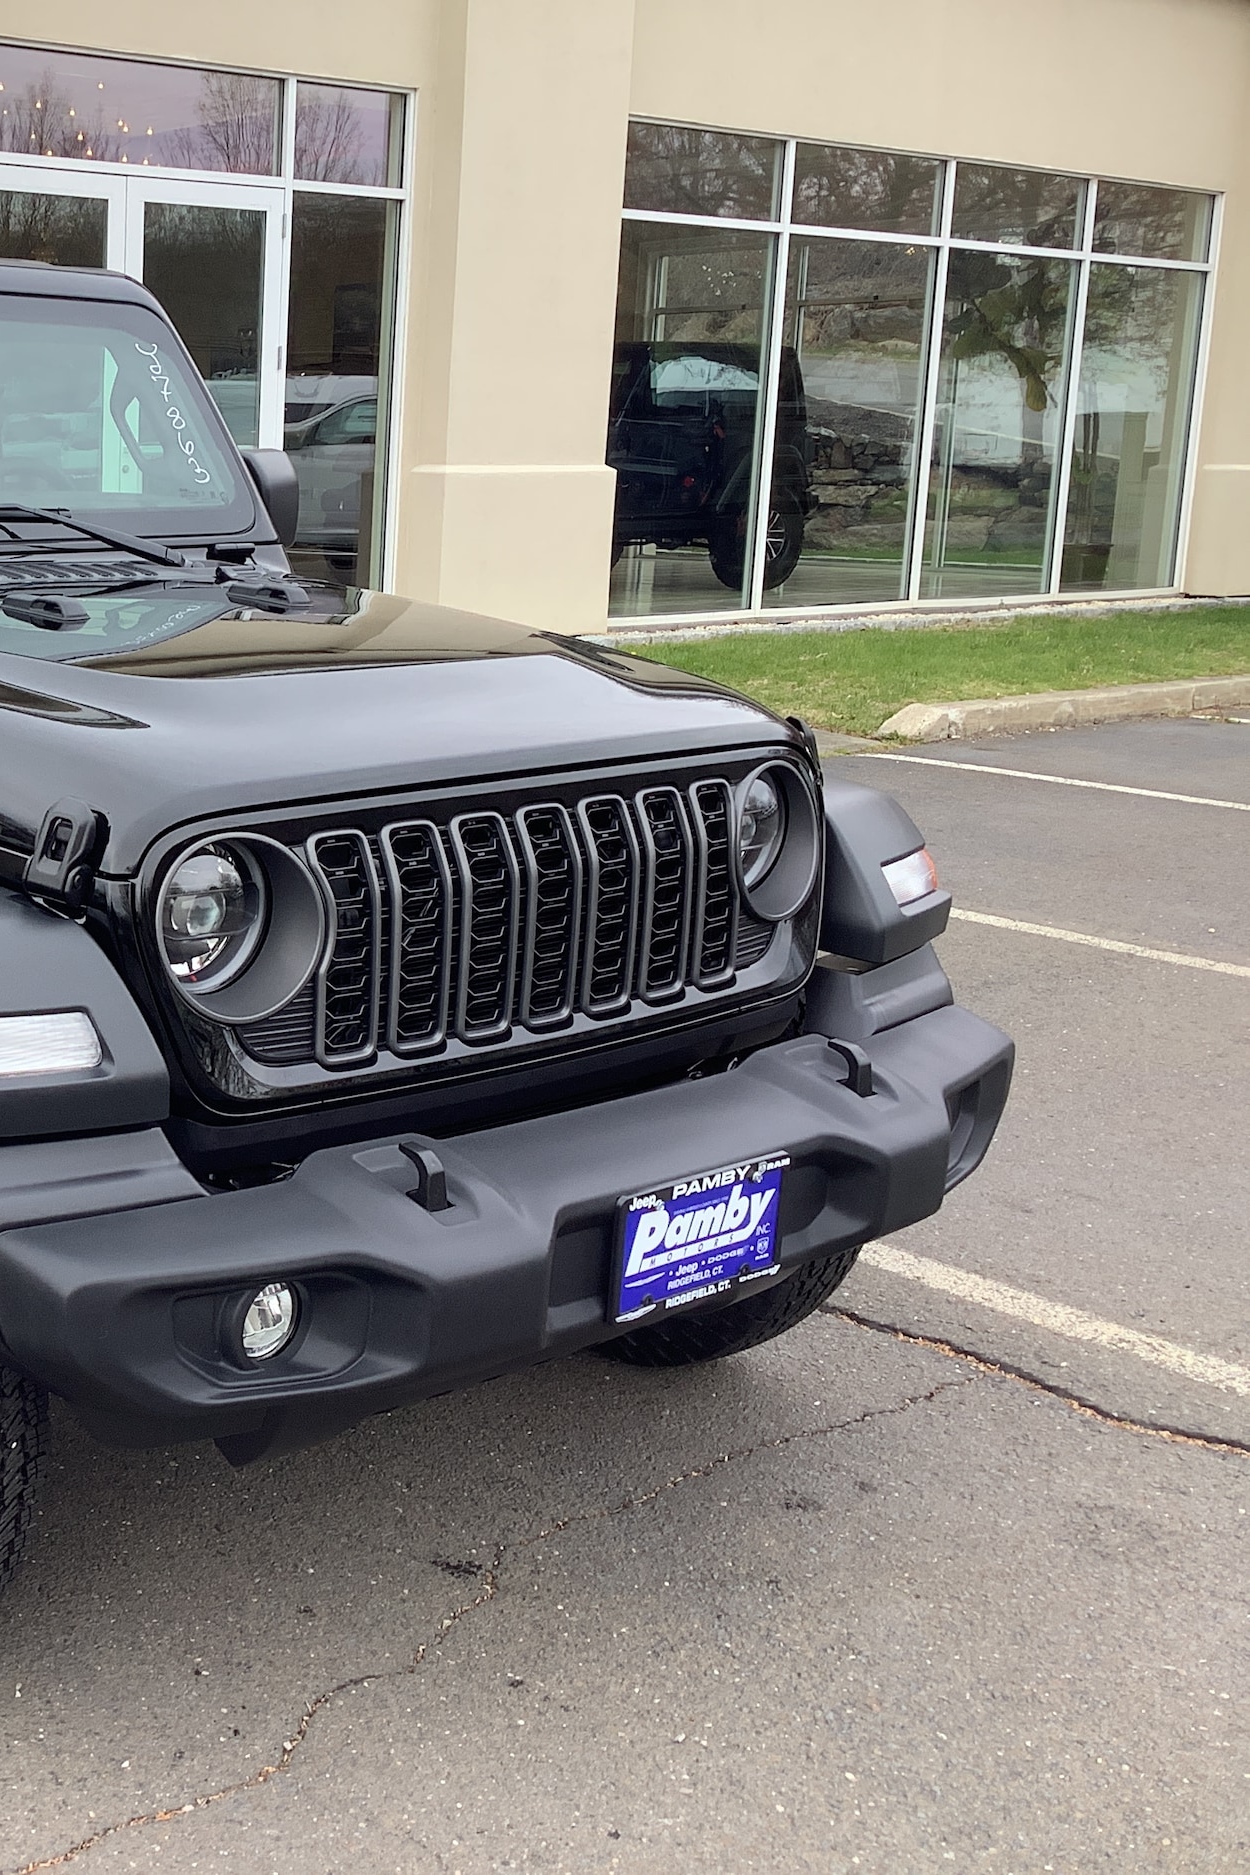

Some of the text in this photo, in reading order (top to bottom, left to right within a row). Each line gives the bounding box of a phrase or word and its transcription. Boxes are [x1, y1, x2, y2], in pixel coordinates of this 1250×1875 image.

[766, 1157, 791, 1171] RAM
[672, 1164, 751, 1200] PAMBY
[629, 1194, 657, 1212] Jeep
[625, 1183, 777, 1278] Pamby
[648, 1233, 734, 1266] MOTORS
[667, 1264, 724, 1291] RIDGEFIELD, CT.
[675, 1259, 699, 1277] Jeep
[665, 1279, 732, 1309] RIDGEFIELD, CT.
